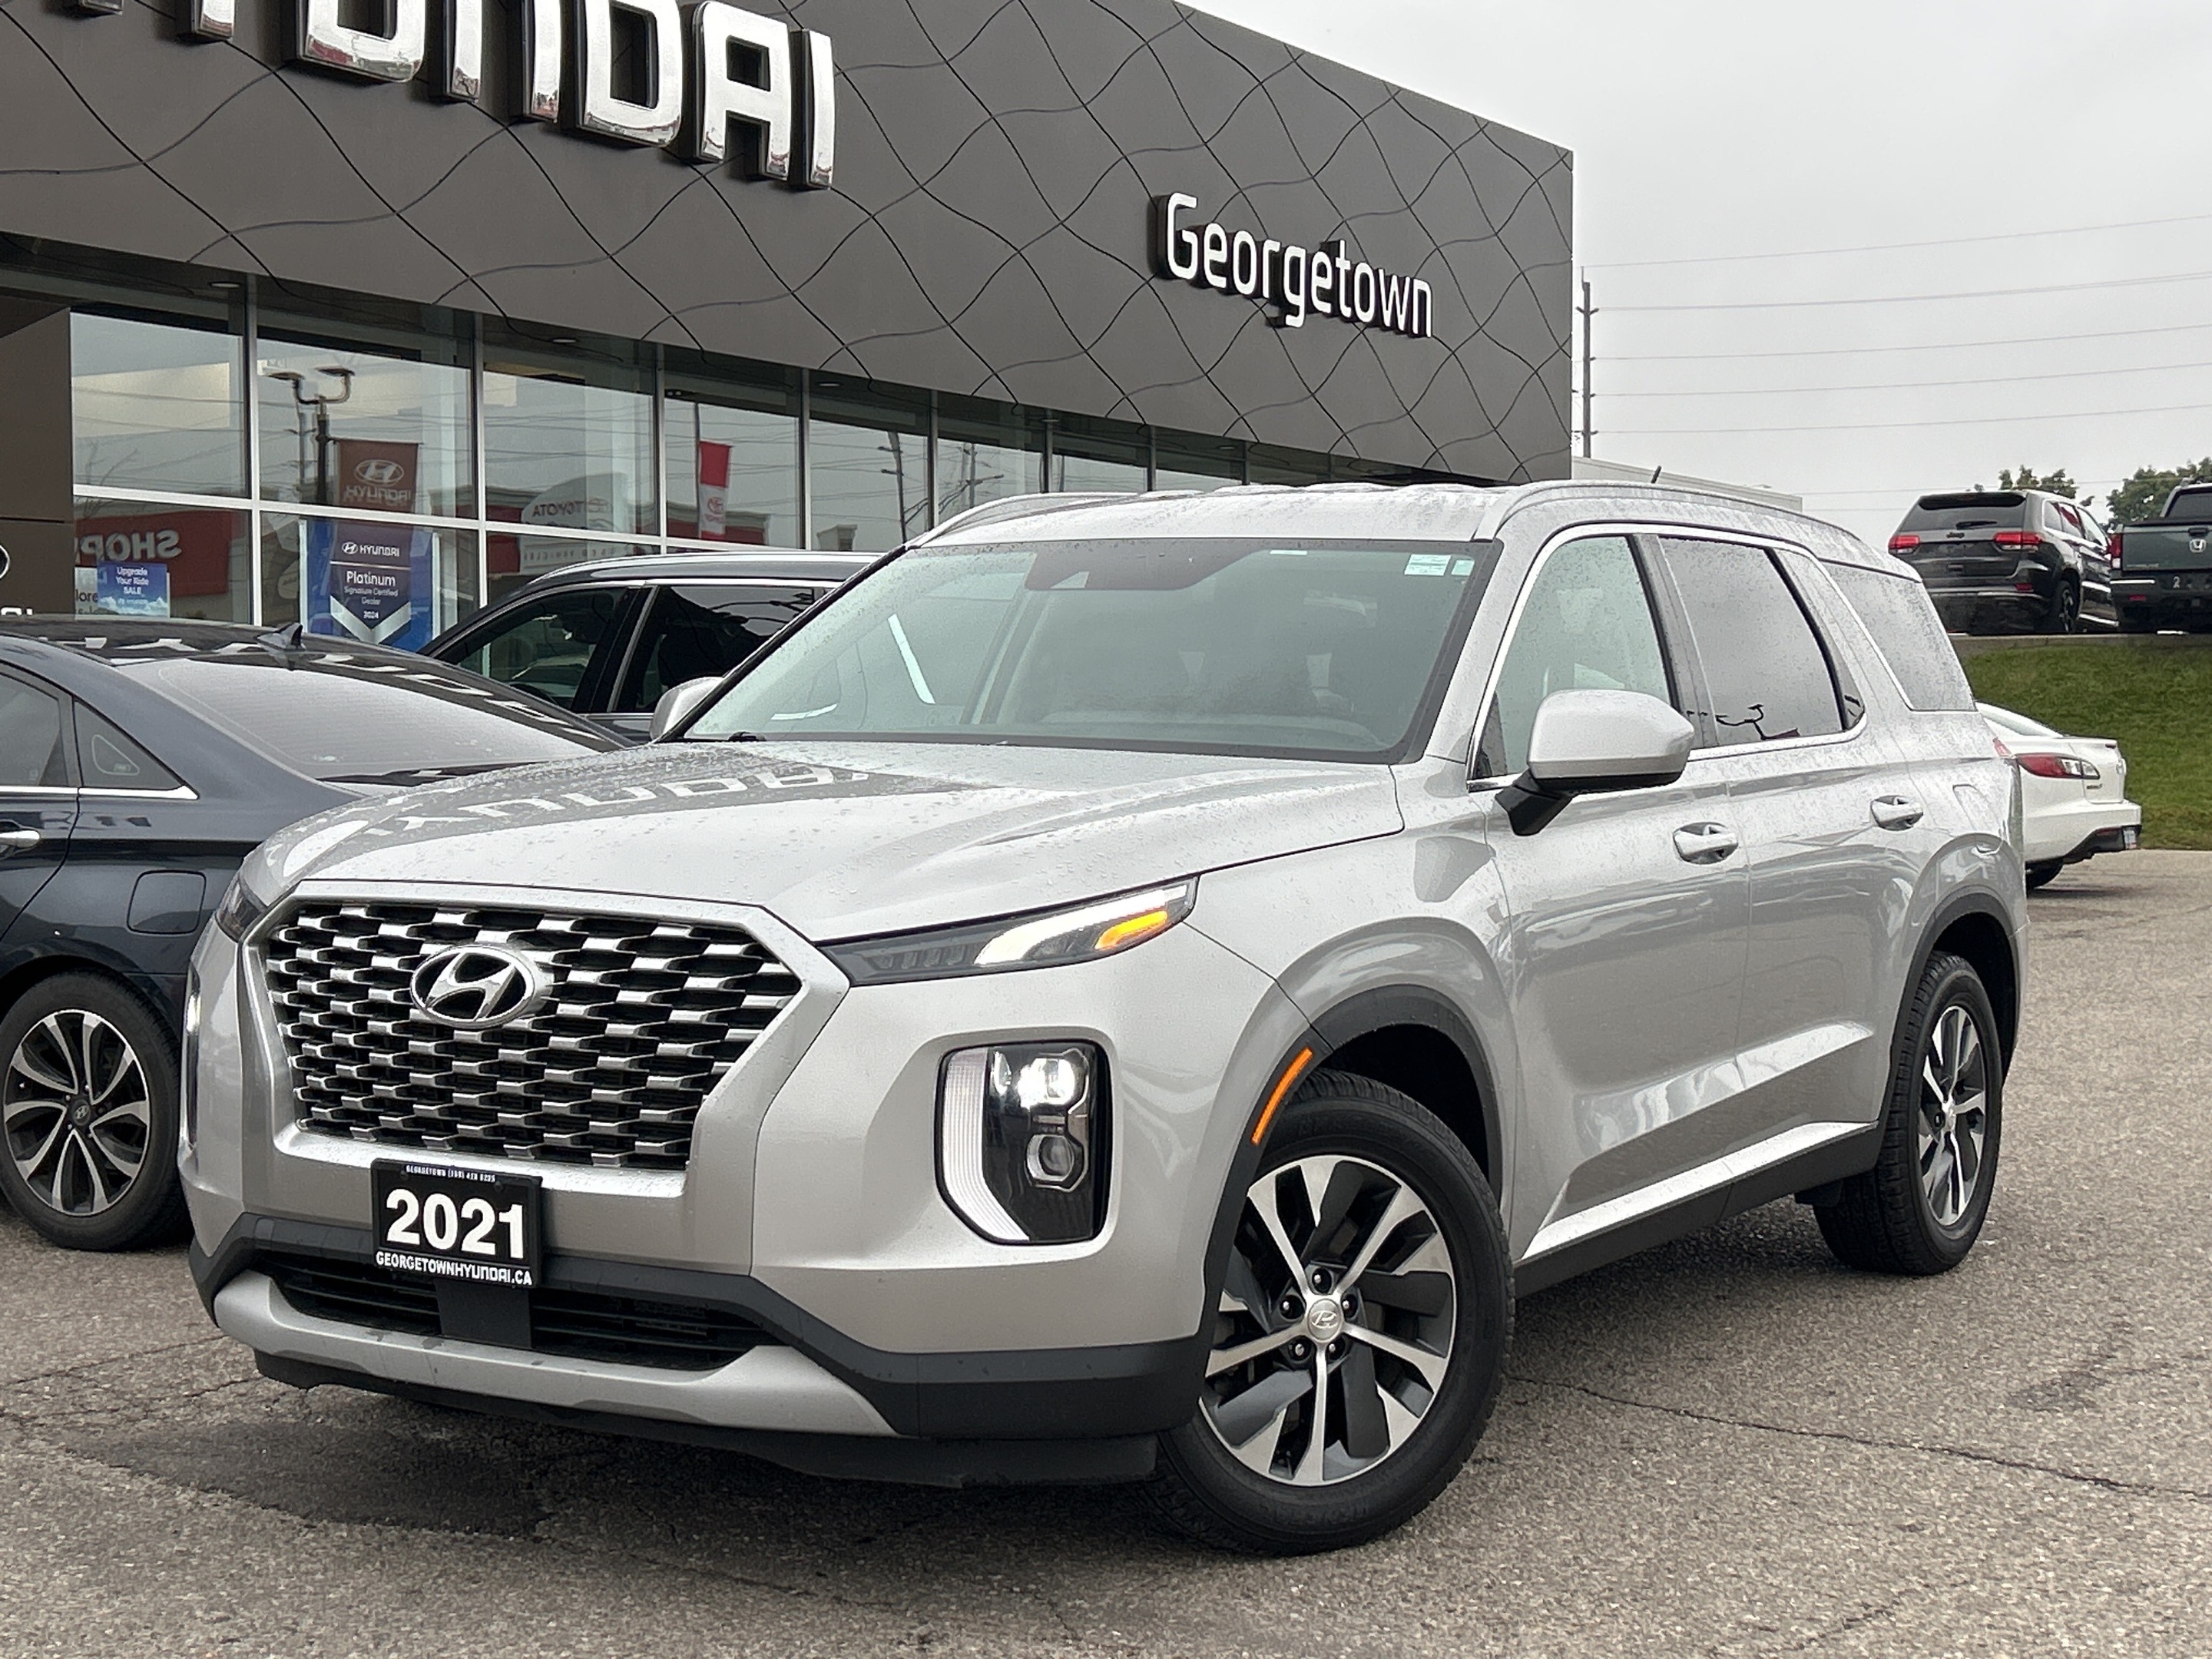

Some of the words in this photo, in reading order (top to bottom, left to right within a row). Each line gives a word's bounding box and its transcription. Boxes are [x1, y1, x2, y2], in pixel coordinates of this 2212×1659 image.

[82, 0, 836, 190] NDAI
[1167, 192, 1432, 336] Georgetown
[359, 545, 399, 557] HYUNDAI
[116, 567, 148, 578] Upgrade
[346, 571, 396, 587] Platinum
[123, 587, 142, 595] SALE
[361, 597, 382, 605] Dealer
[386, 1189, 524, 1259] 2021
[376, 1251, 532, 1285] GEORGETOWNHYUNDAI.CA
